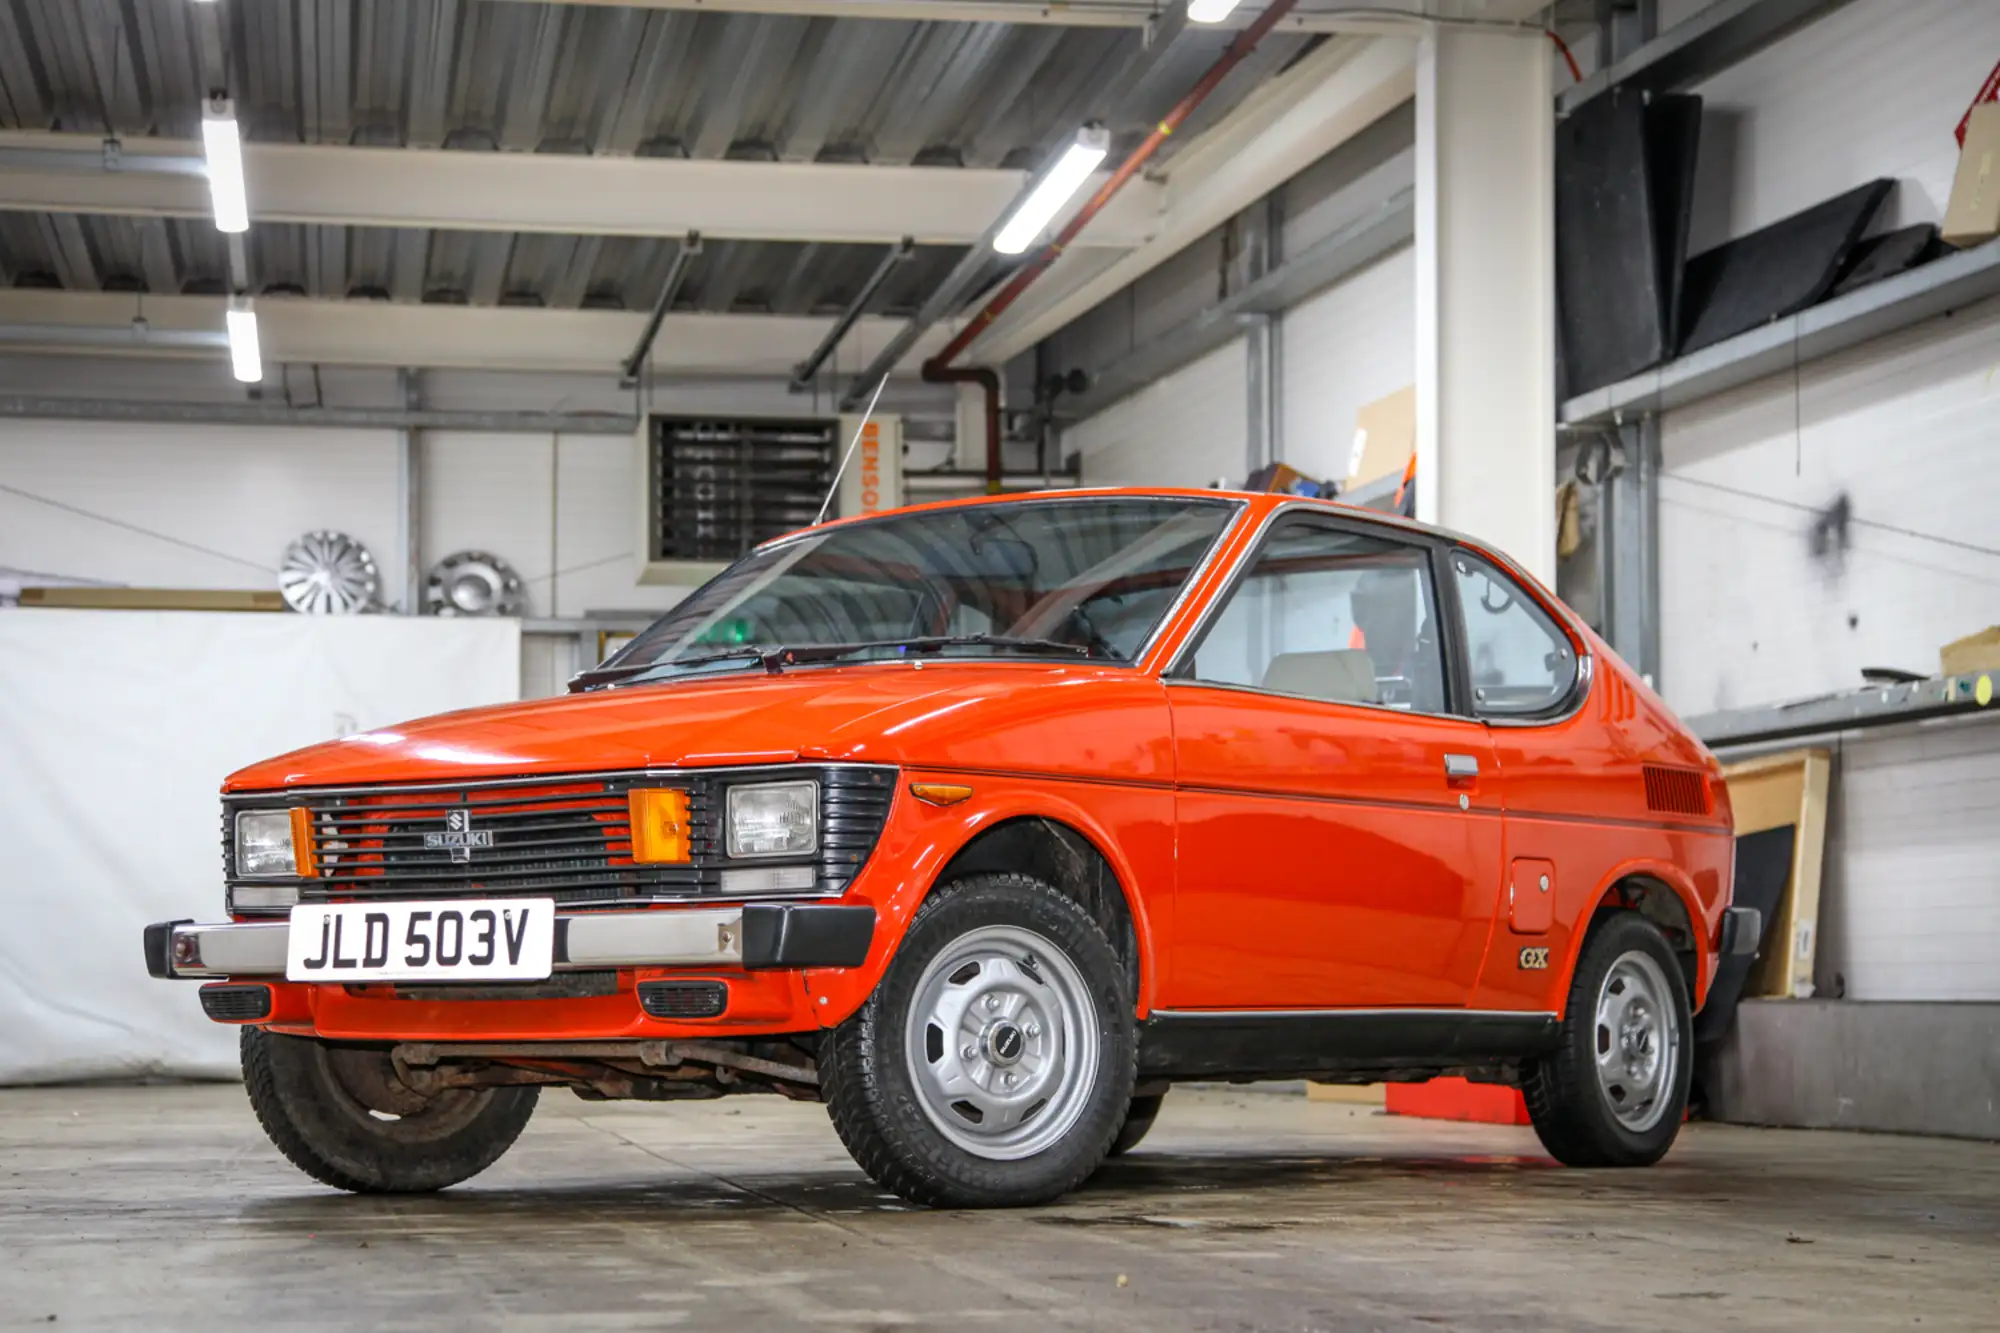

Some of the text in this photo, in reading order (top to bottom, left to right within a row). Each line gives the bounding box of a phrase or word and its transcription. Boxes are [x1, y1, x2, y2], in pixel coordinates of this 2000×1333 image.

[861, 423, 879, 514] BENSO
[426, 832, 488, 848] SUZUKI
[303, 908, 531, 970] JLD 503V
[1520, 947, 1549, 969] GX
